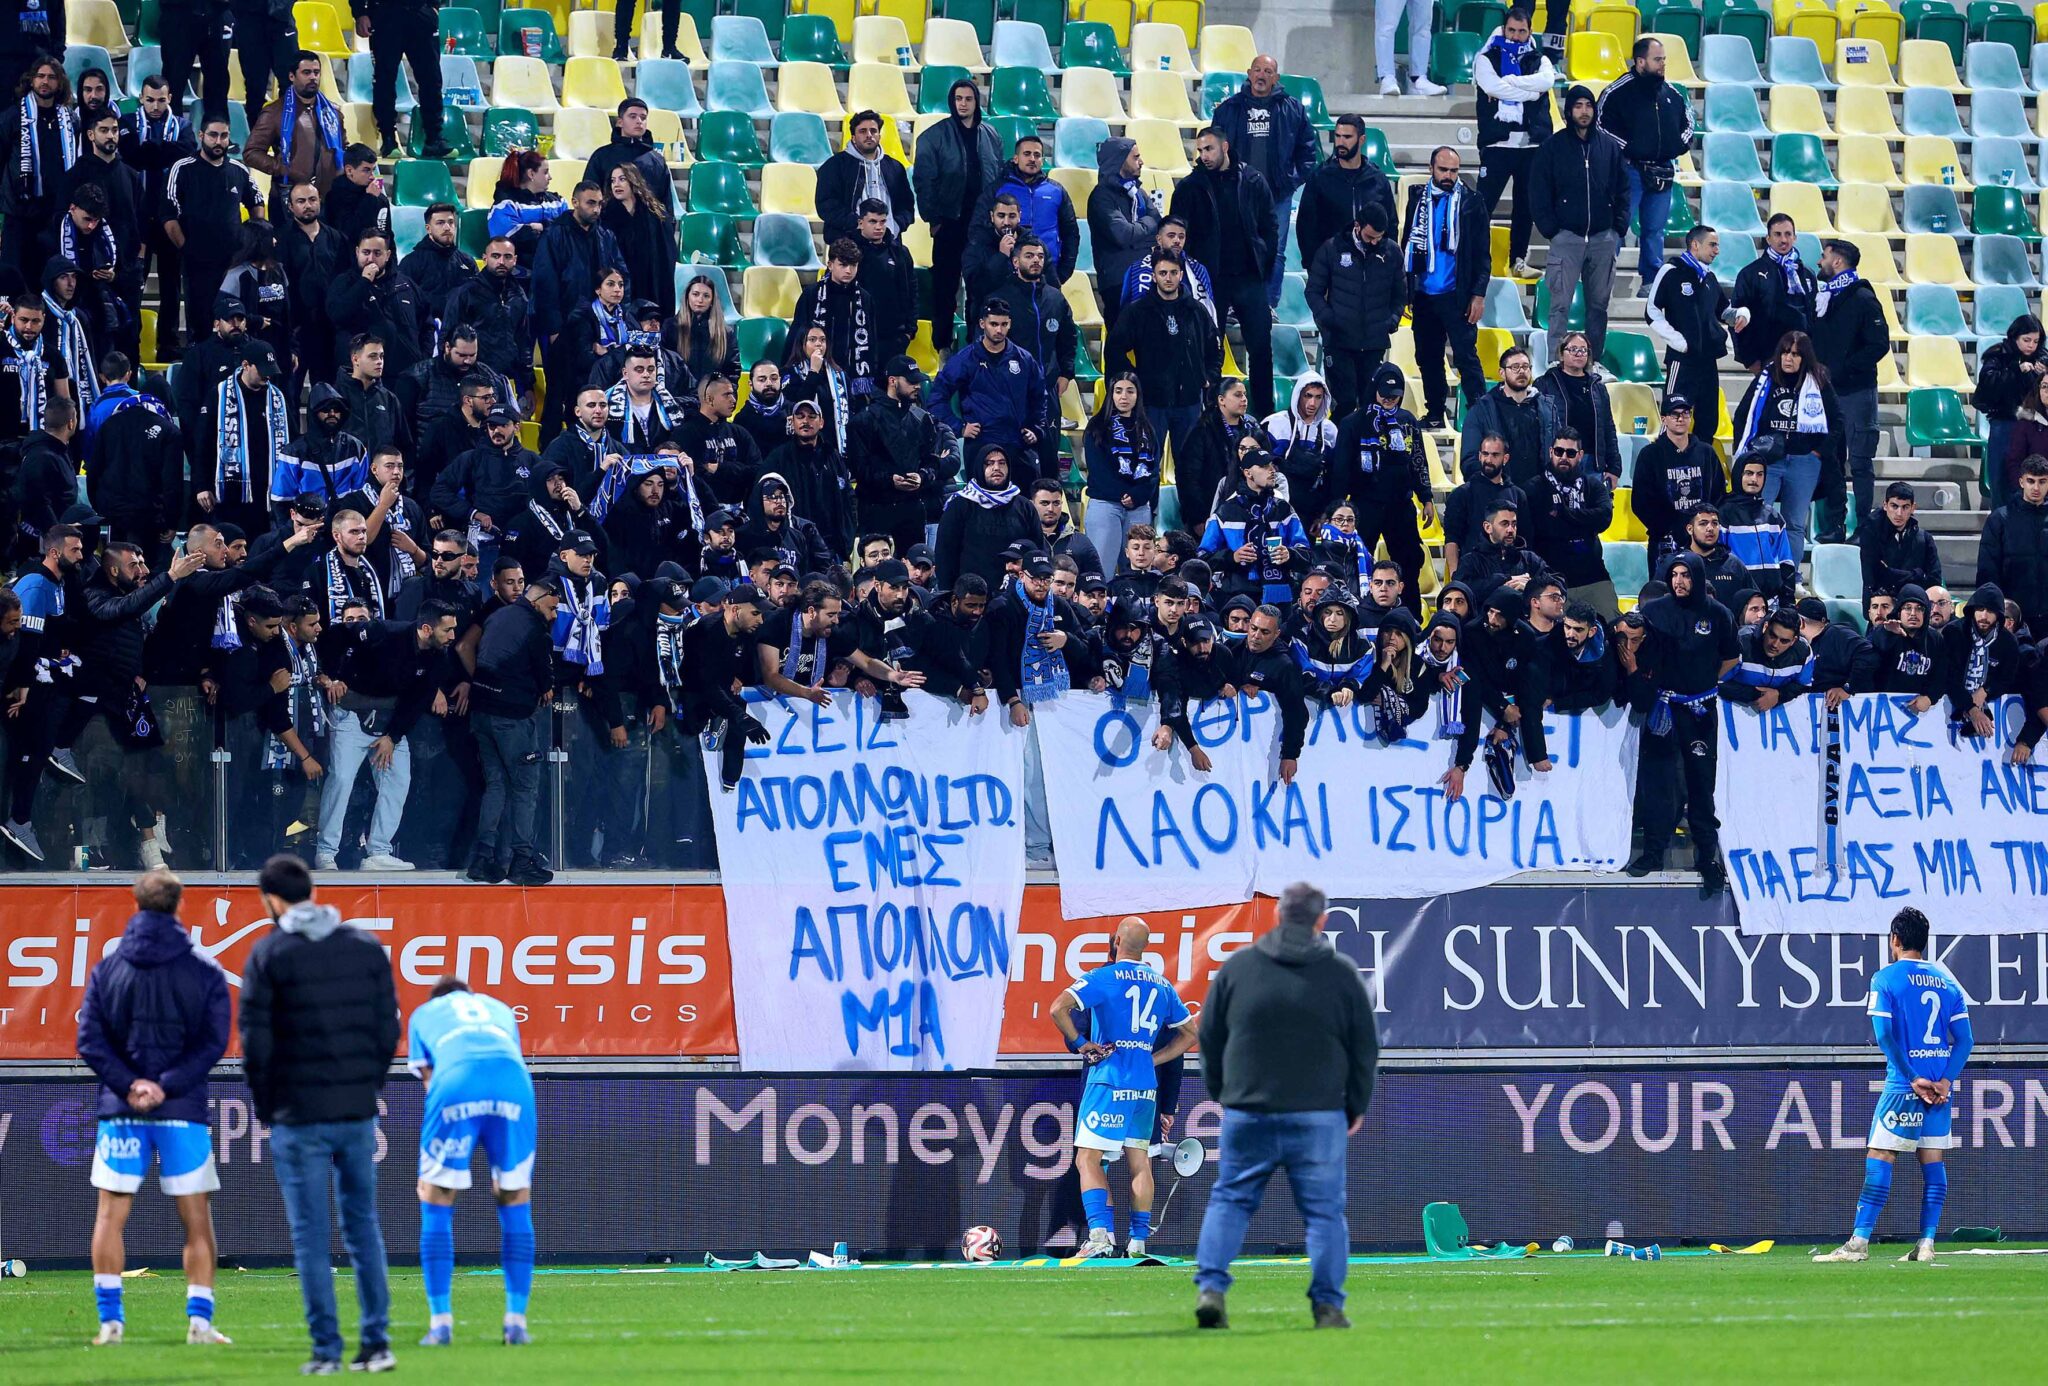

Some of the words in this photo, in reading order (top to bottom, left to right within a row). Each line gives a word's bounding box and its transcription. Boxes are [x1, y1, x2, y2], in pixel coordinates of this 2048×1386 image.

[1824, 742, 1842, 828] ΘΥΡΑ
[1845, 762, 1954, 821] ΑΞΙΑ
[1907, 974, 1947, 990] VOUROS
[1125, 984, 1159, 1037] 14
[1920, 990, 1942, 1045] 2
[1100, 1113, 1125, 1124] GVD
[1501, 1080, 1736, 1154] YOUR
[1899, 1111, 1924, 1122] GVD
